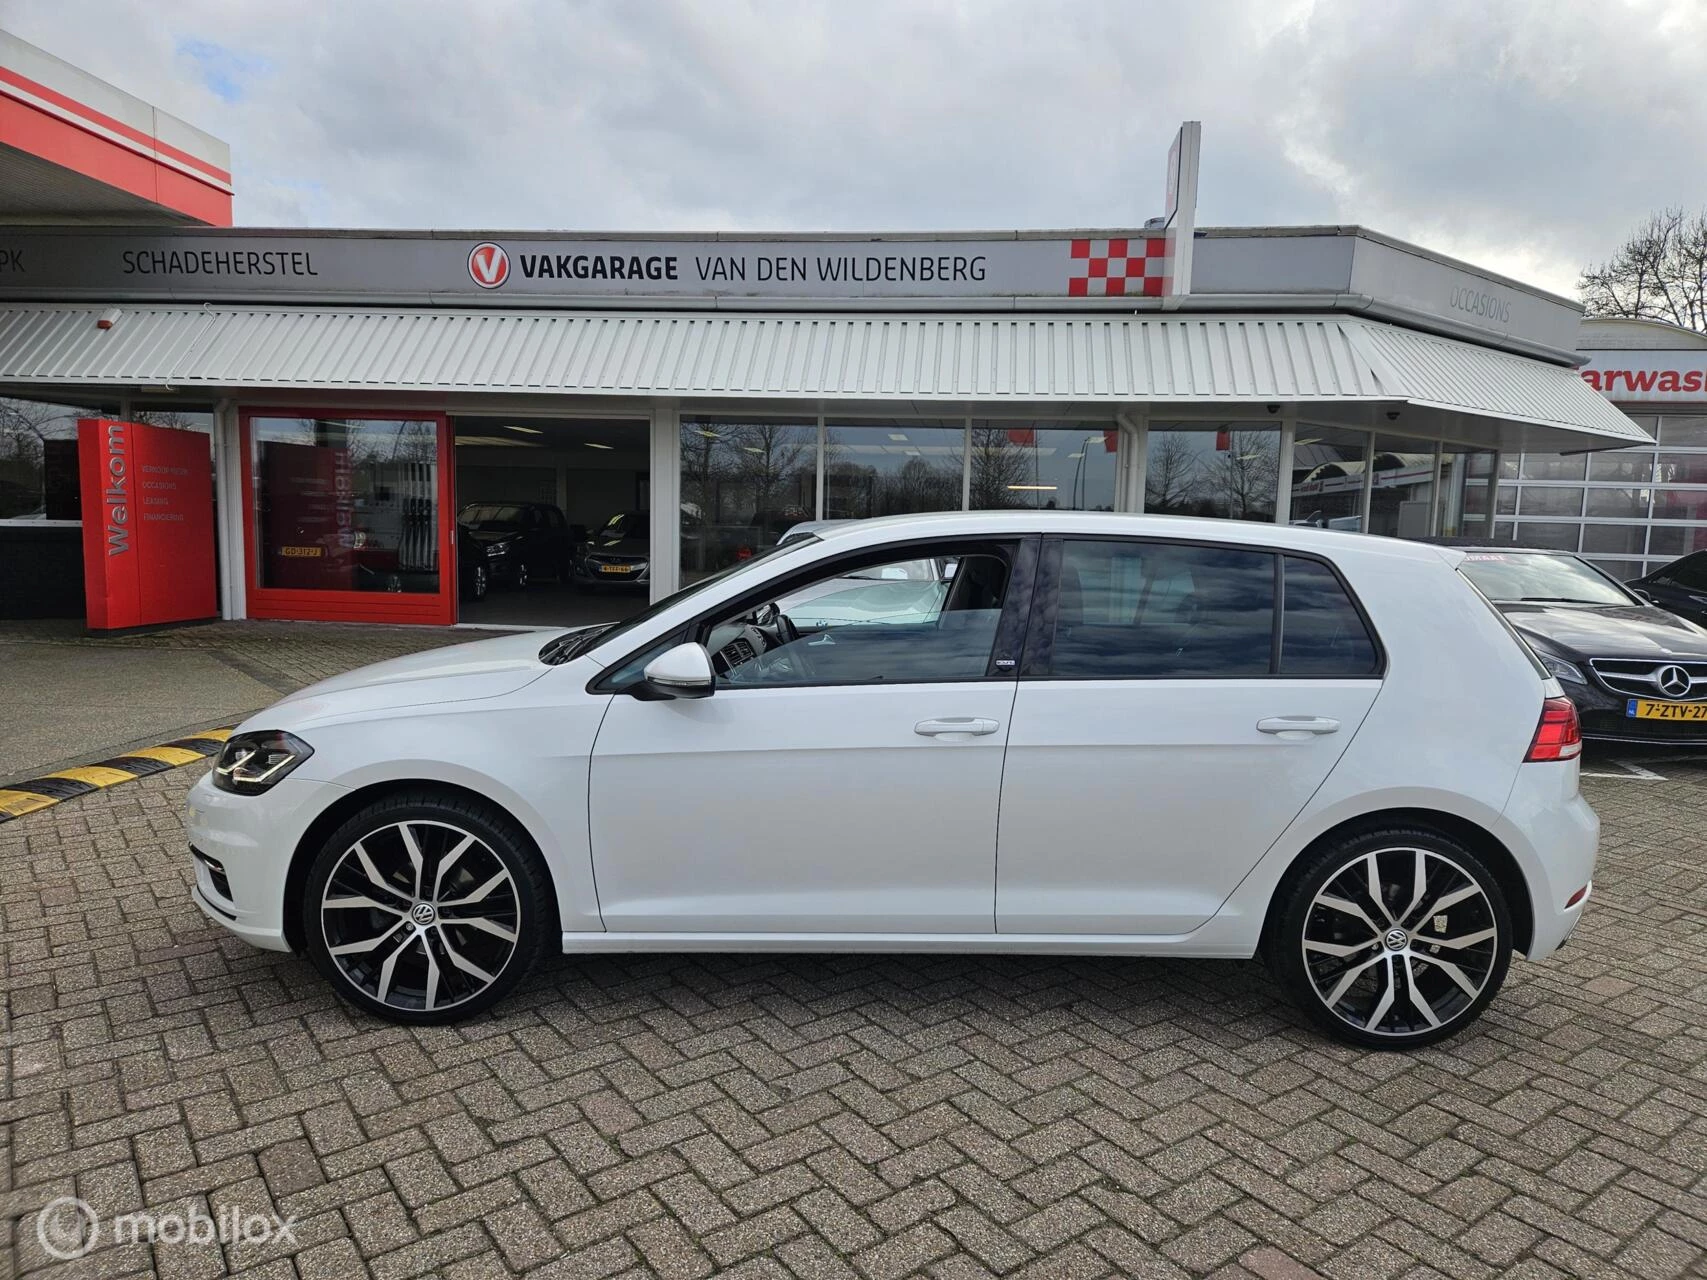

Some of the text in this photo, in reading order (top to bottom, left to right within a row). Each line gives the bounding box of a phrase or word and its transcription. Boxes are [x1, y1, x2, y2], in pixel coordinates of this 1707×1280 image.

[123, 251, 318, 276] SCHADEHERSTEL
[520, 255, 987, 282] VAKGARAGE VAN DEN WILDENBERG
[1450, 286, 1511, 323] OCCASIONS
[1580, 368, 1707, 392] arwas
[106, 425, 129, 556] Welkom
